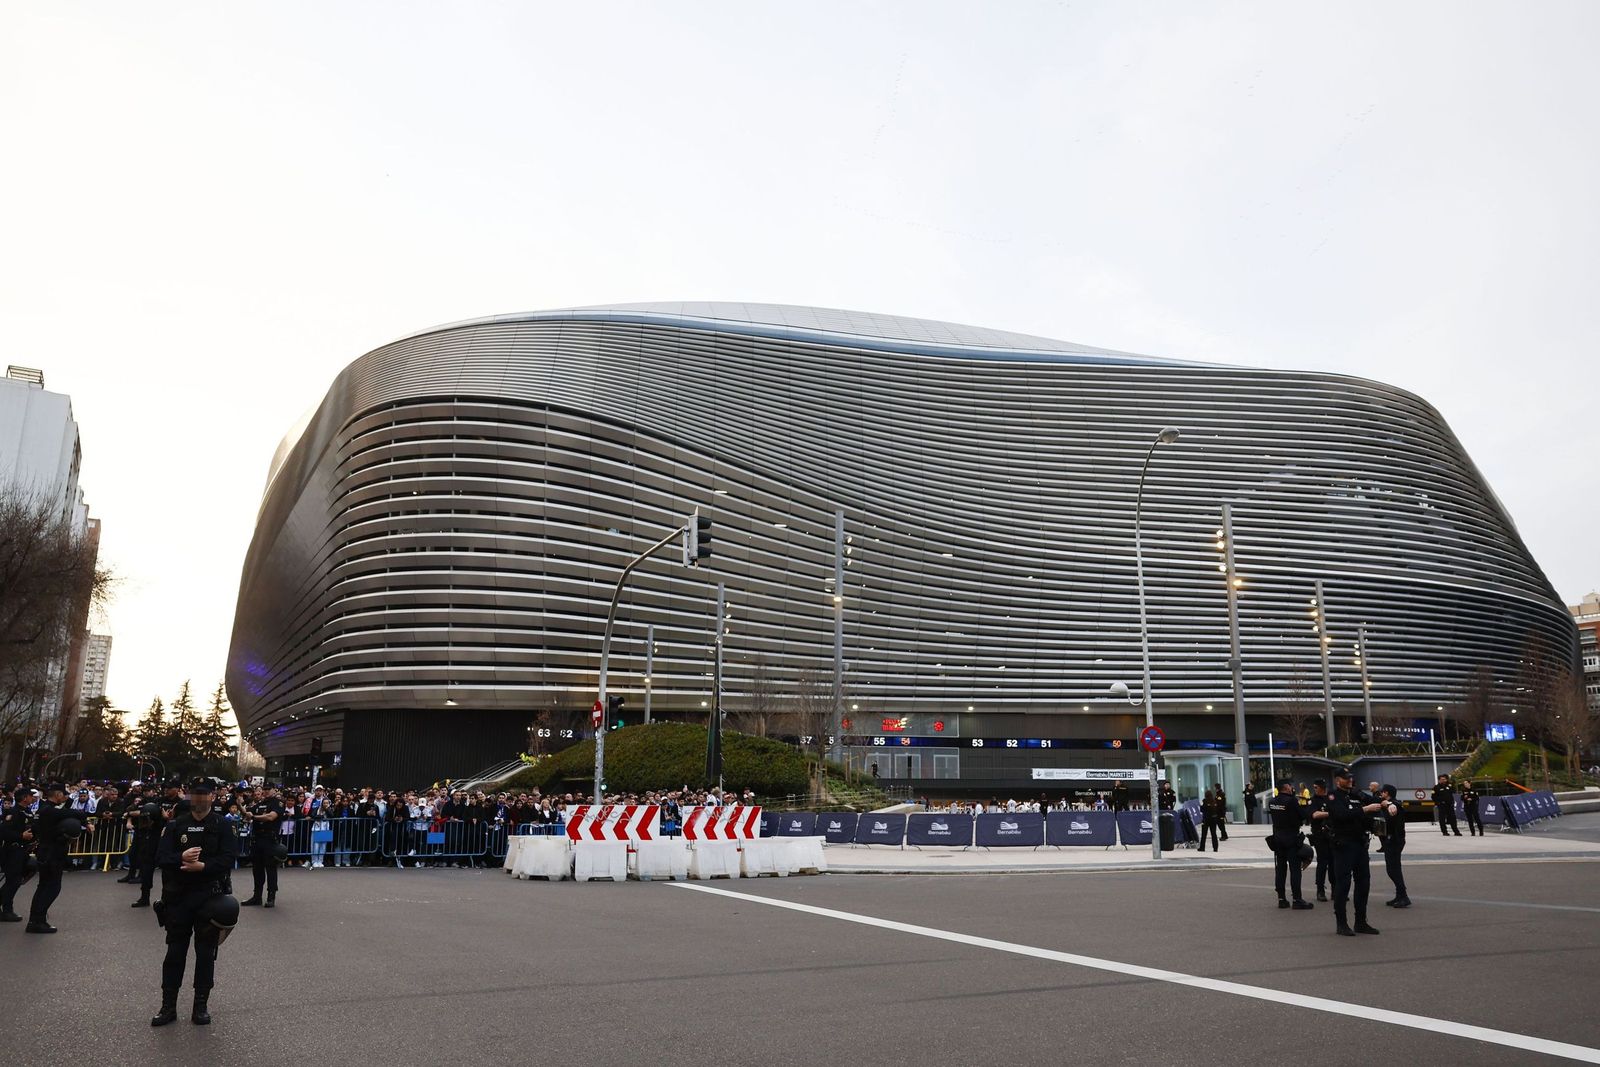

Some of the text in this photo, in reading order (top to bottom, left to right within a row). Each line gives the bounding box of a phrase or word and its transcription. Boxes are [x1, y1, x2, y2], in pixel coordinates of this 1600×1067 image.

[538, 729, 550, 737] 63
[873, 738, 885, 746] 55
[901, 738, 910, 746] 54
[972, 739, 983, 747] 53
[1041, 740, 1051, 748] 51
[1112, 740, 1122, 748] 50
